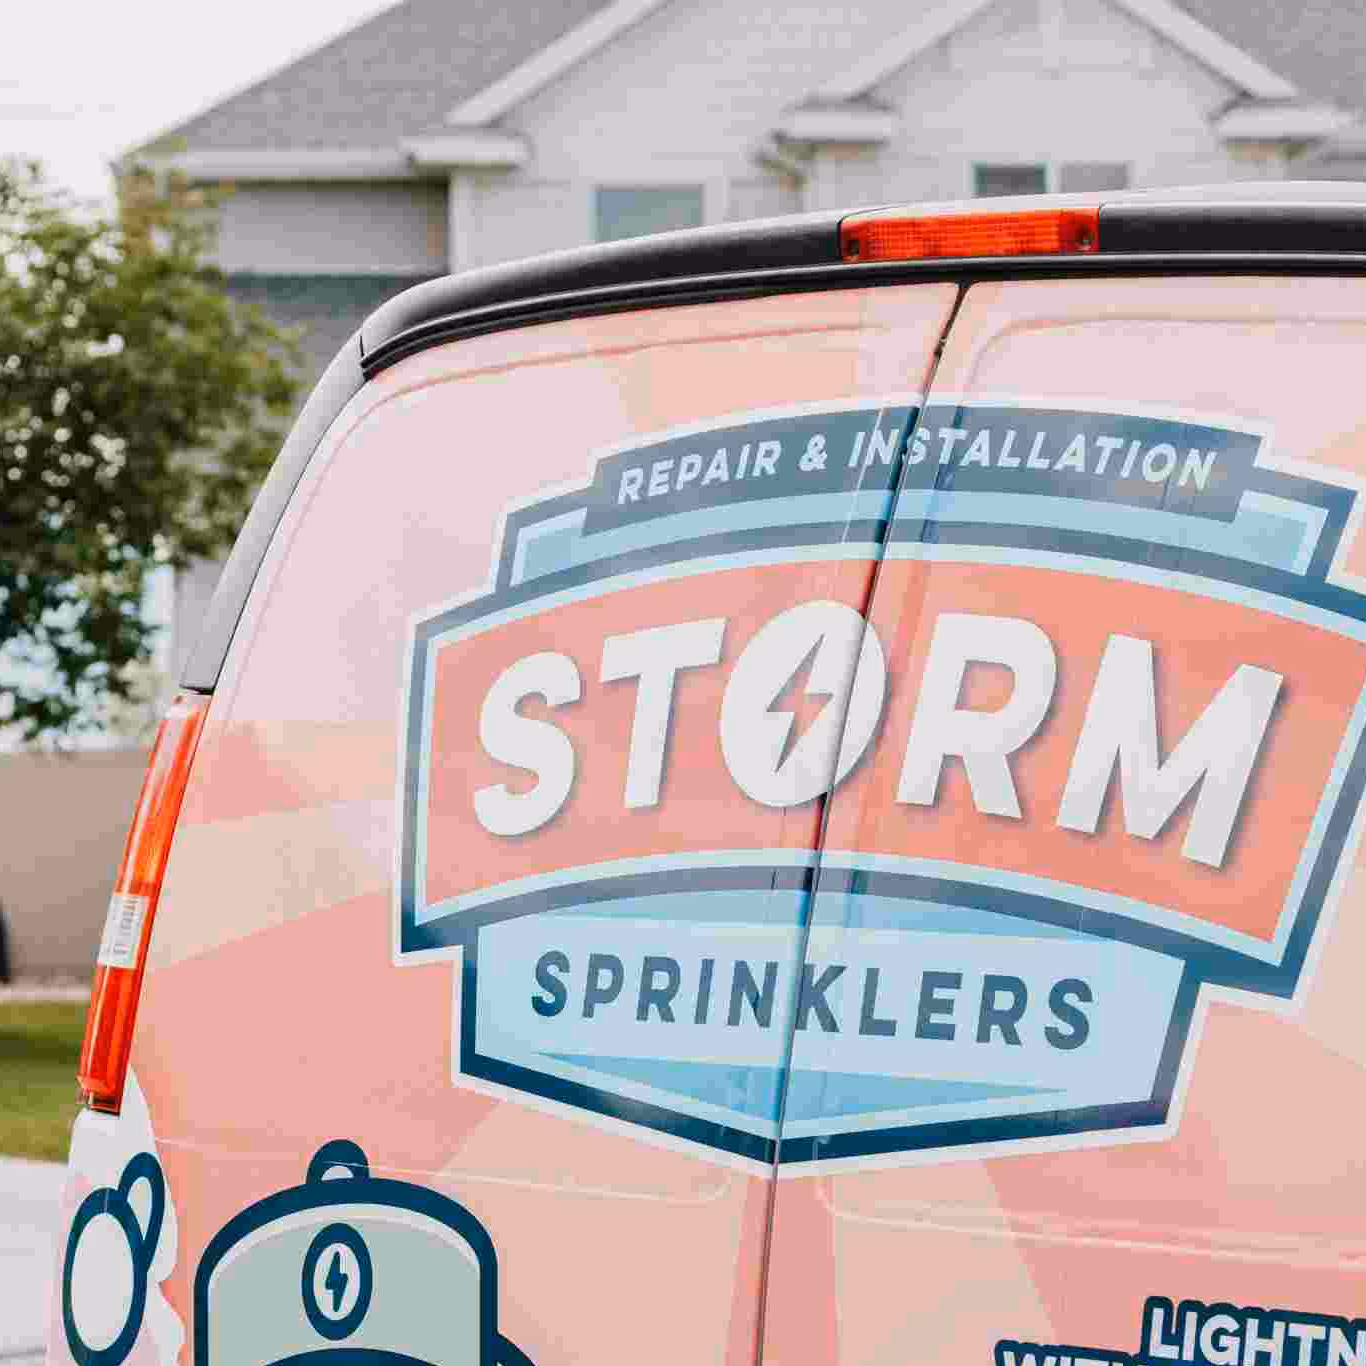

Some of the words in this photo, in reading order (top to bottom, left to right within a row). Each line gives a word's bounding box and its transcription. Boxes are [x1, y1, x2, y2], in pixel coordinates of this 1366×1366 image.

[617, 440, 782, 505] REPAIR
[800, 434, 829, 472] &
[849, 427, 1219, 492] INSTALLATION
[471, 600, 1284, 871] STORM
[530, 950, 1094, 1051] SPRINKLERS
